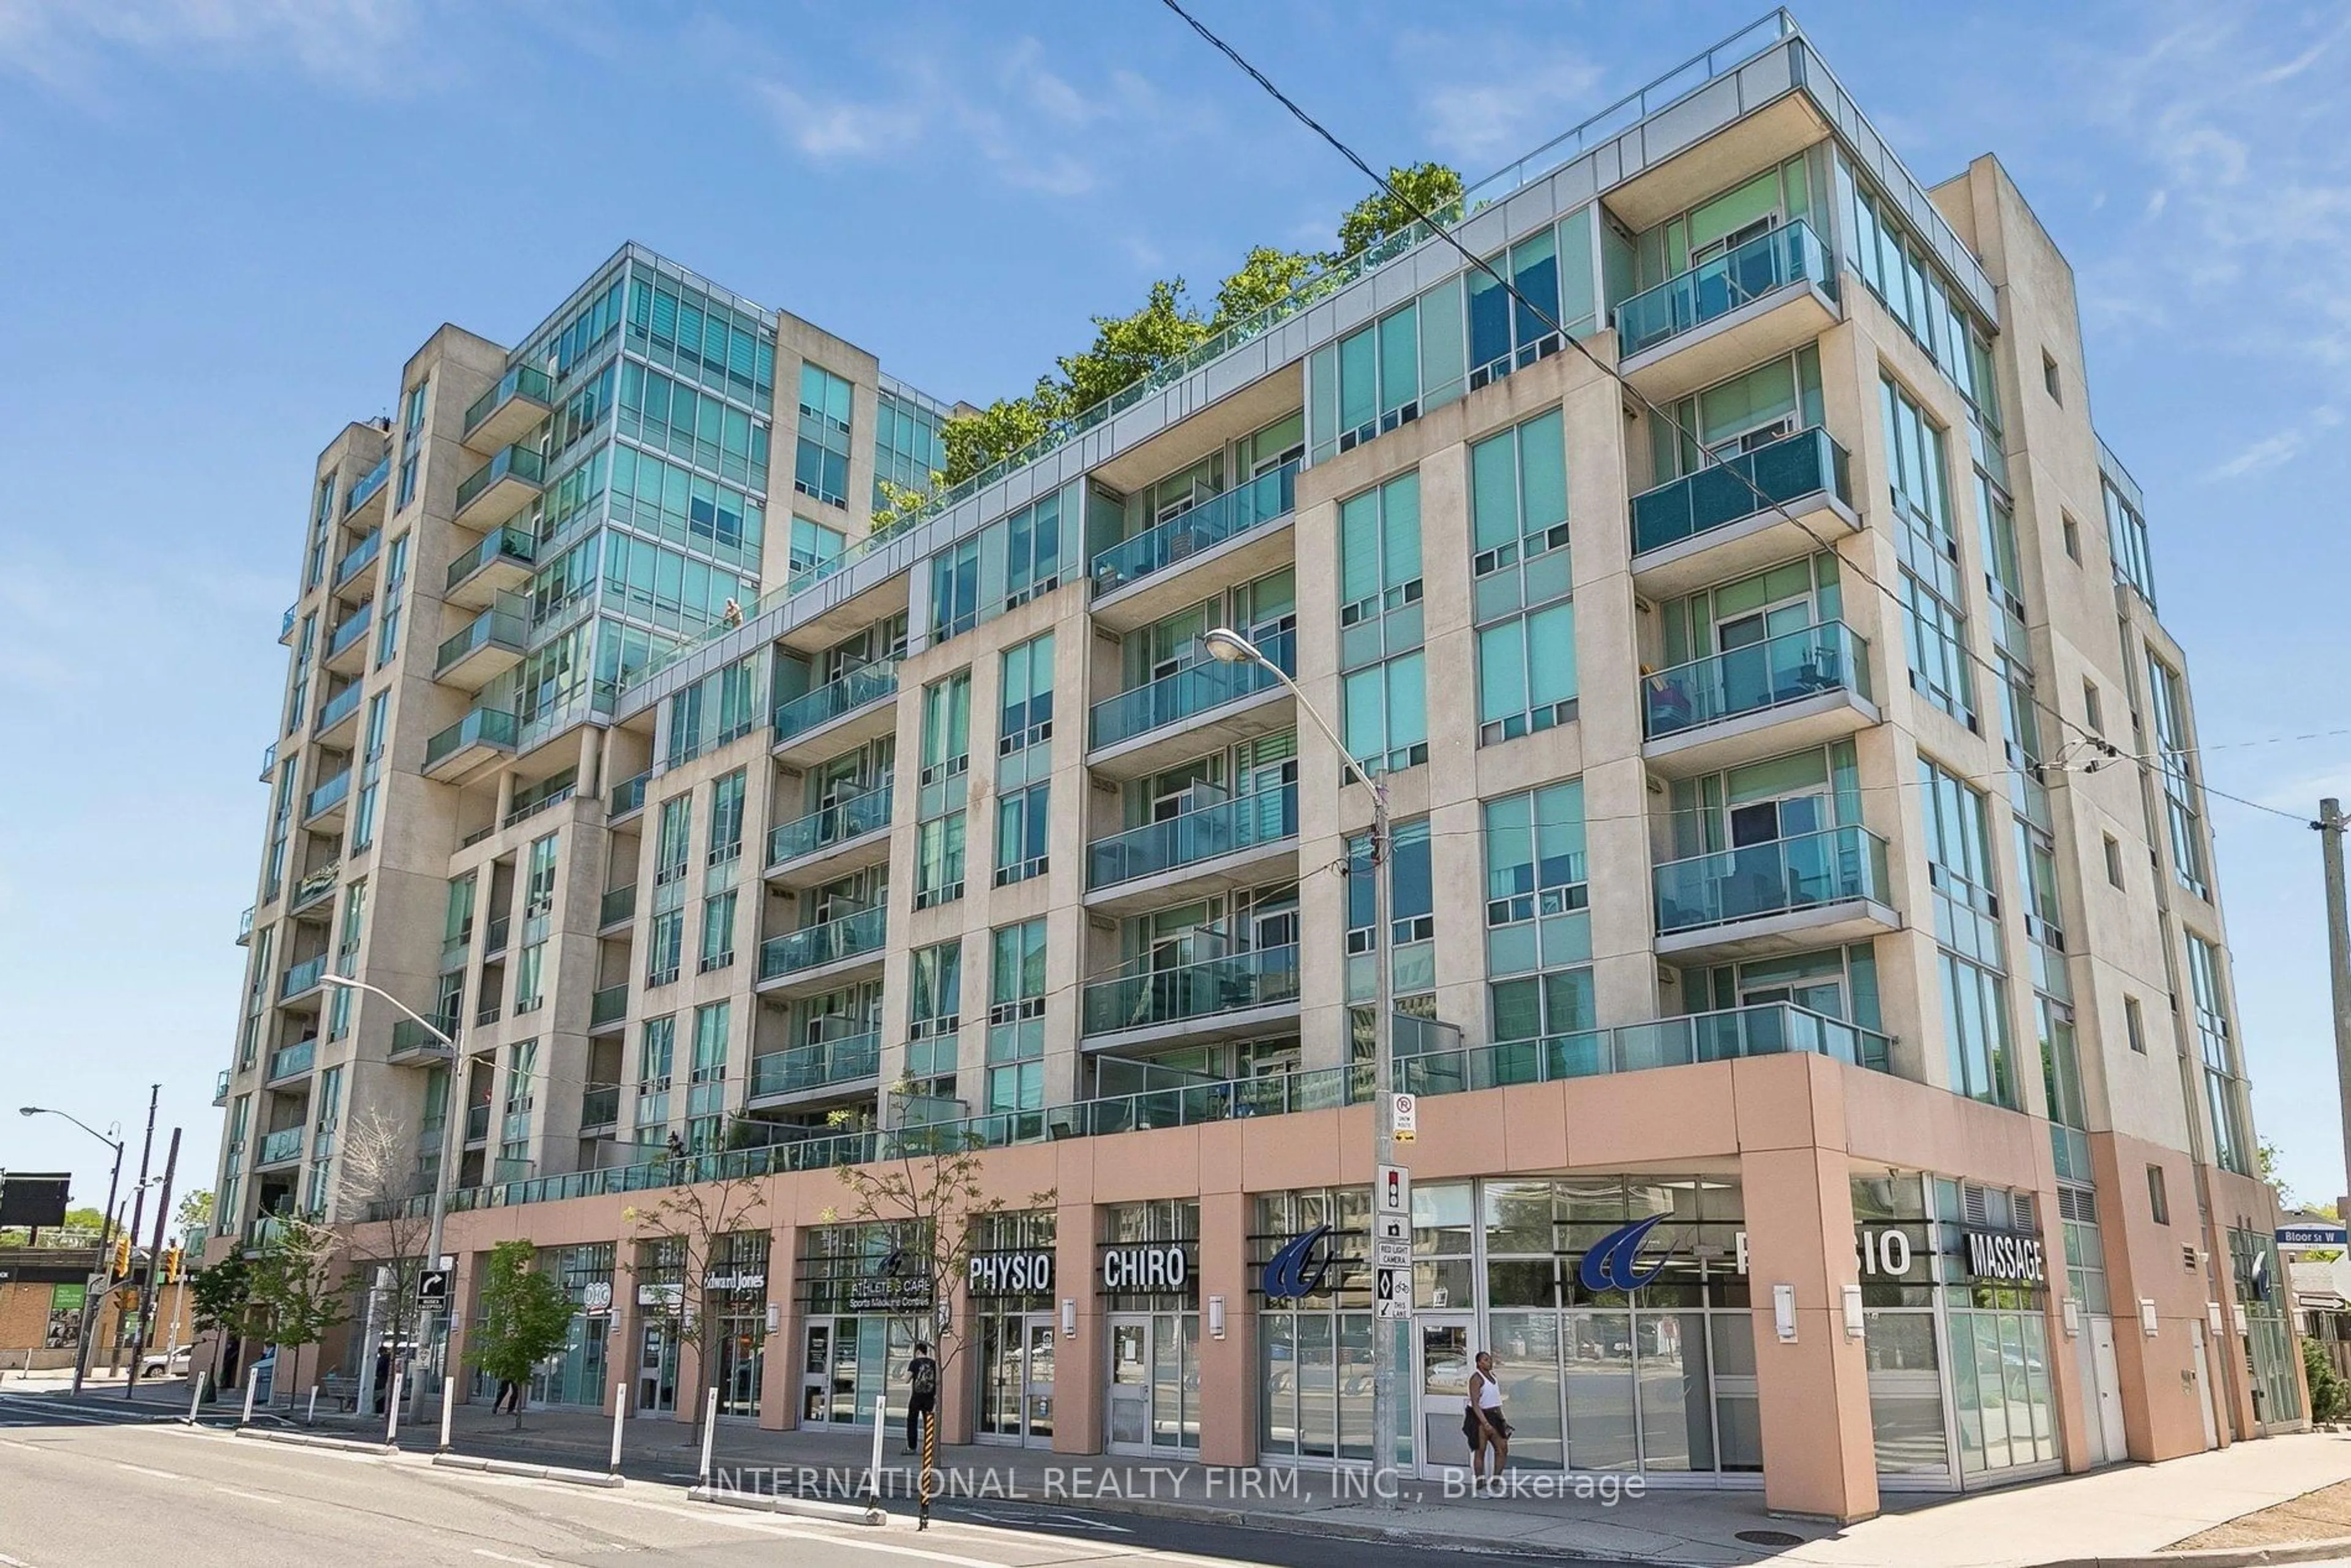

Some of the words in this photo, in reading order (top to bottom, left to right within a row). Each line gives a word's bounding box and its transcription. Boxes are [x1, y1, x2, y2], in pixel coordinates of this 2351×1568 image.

[2285, 1231, 2311, 1242] Bloor
[2325, 1232, 2335, 1242] W
[1381, 1245, 1391, 1253] RED
[1392, 1246, 1408, 1255] LIGHT
[1384, 1255, 1406, 1264] CAMERA
[1969, 1233, 2044, 1281] MASSAGE
[970, 1255, 1049, 1289] PHYSIO
[1104, 1248, 1184, 1287] CHIRO
[735, 1270, 764, 1292] Jones
[904, 1280, 930, 1292] CARE
[850, 1298, 870, 1308] Sports
